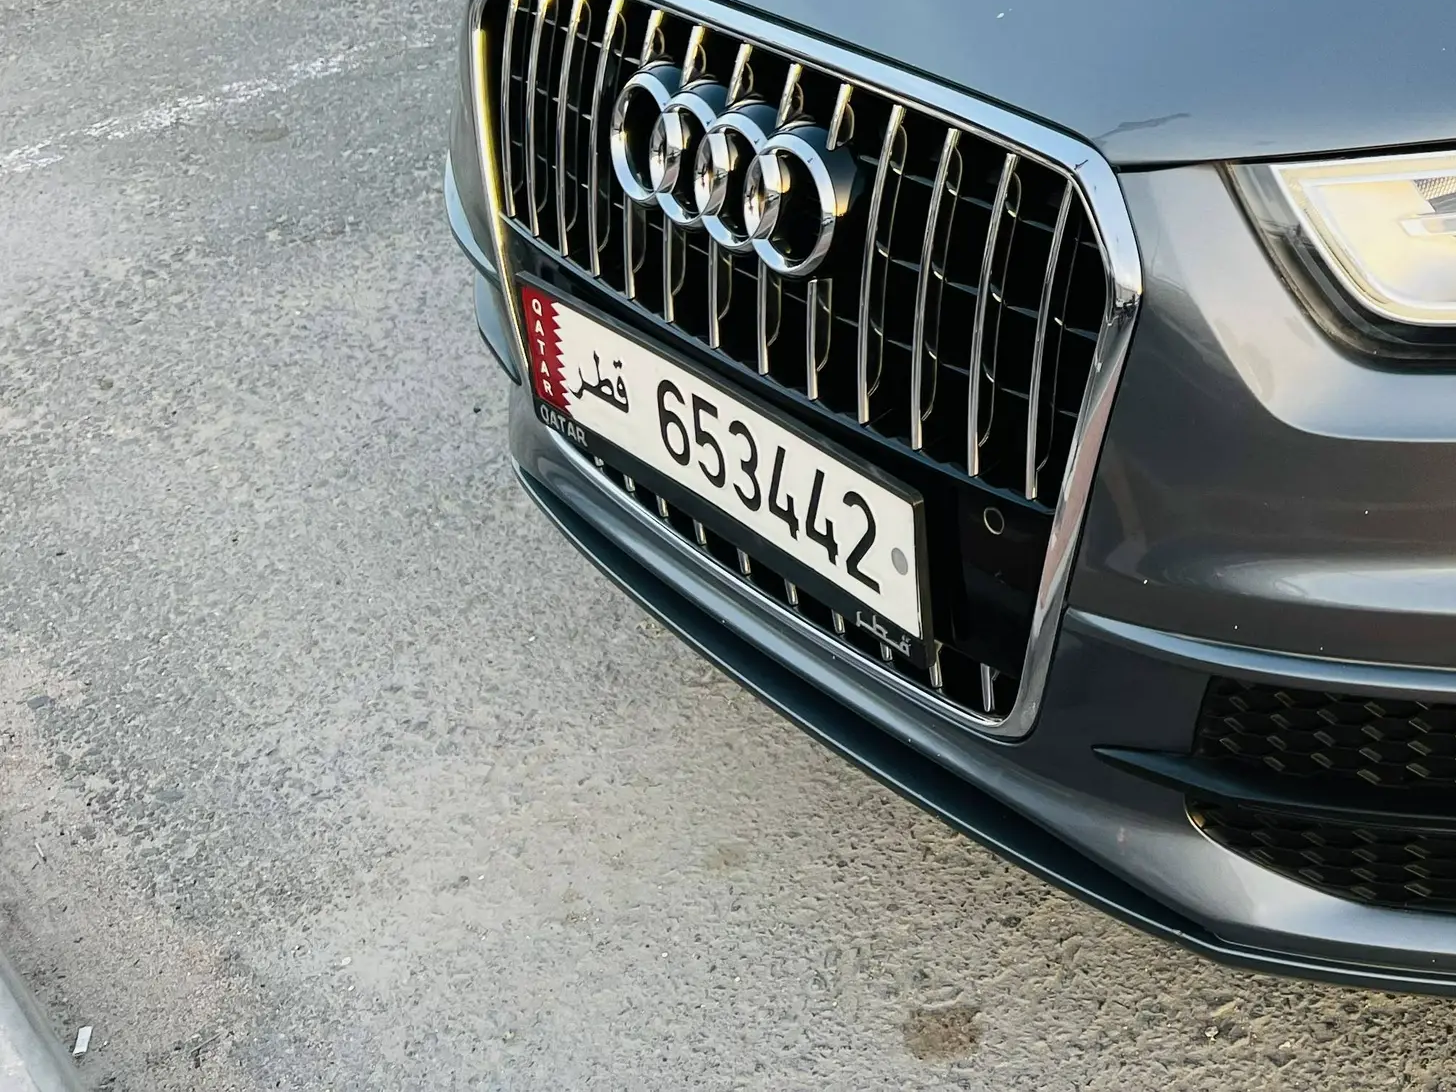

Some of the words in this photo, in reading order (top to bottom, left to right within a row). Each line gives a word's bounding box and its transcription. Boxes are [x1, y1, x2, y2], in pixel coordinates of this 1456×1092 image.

[531, 298, 554, 397] QATAR
[569, 349, 630, 414] قطر
[540, 403, 588, 447] QATAR
[656, 379, 881, 595] 653442
[856, 610, 912, 657] قطر
